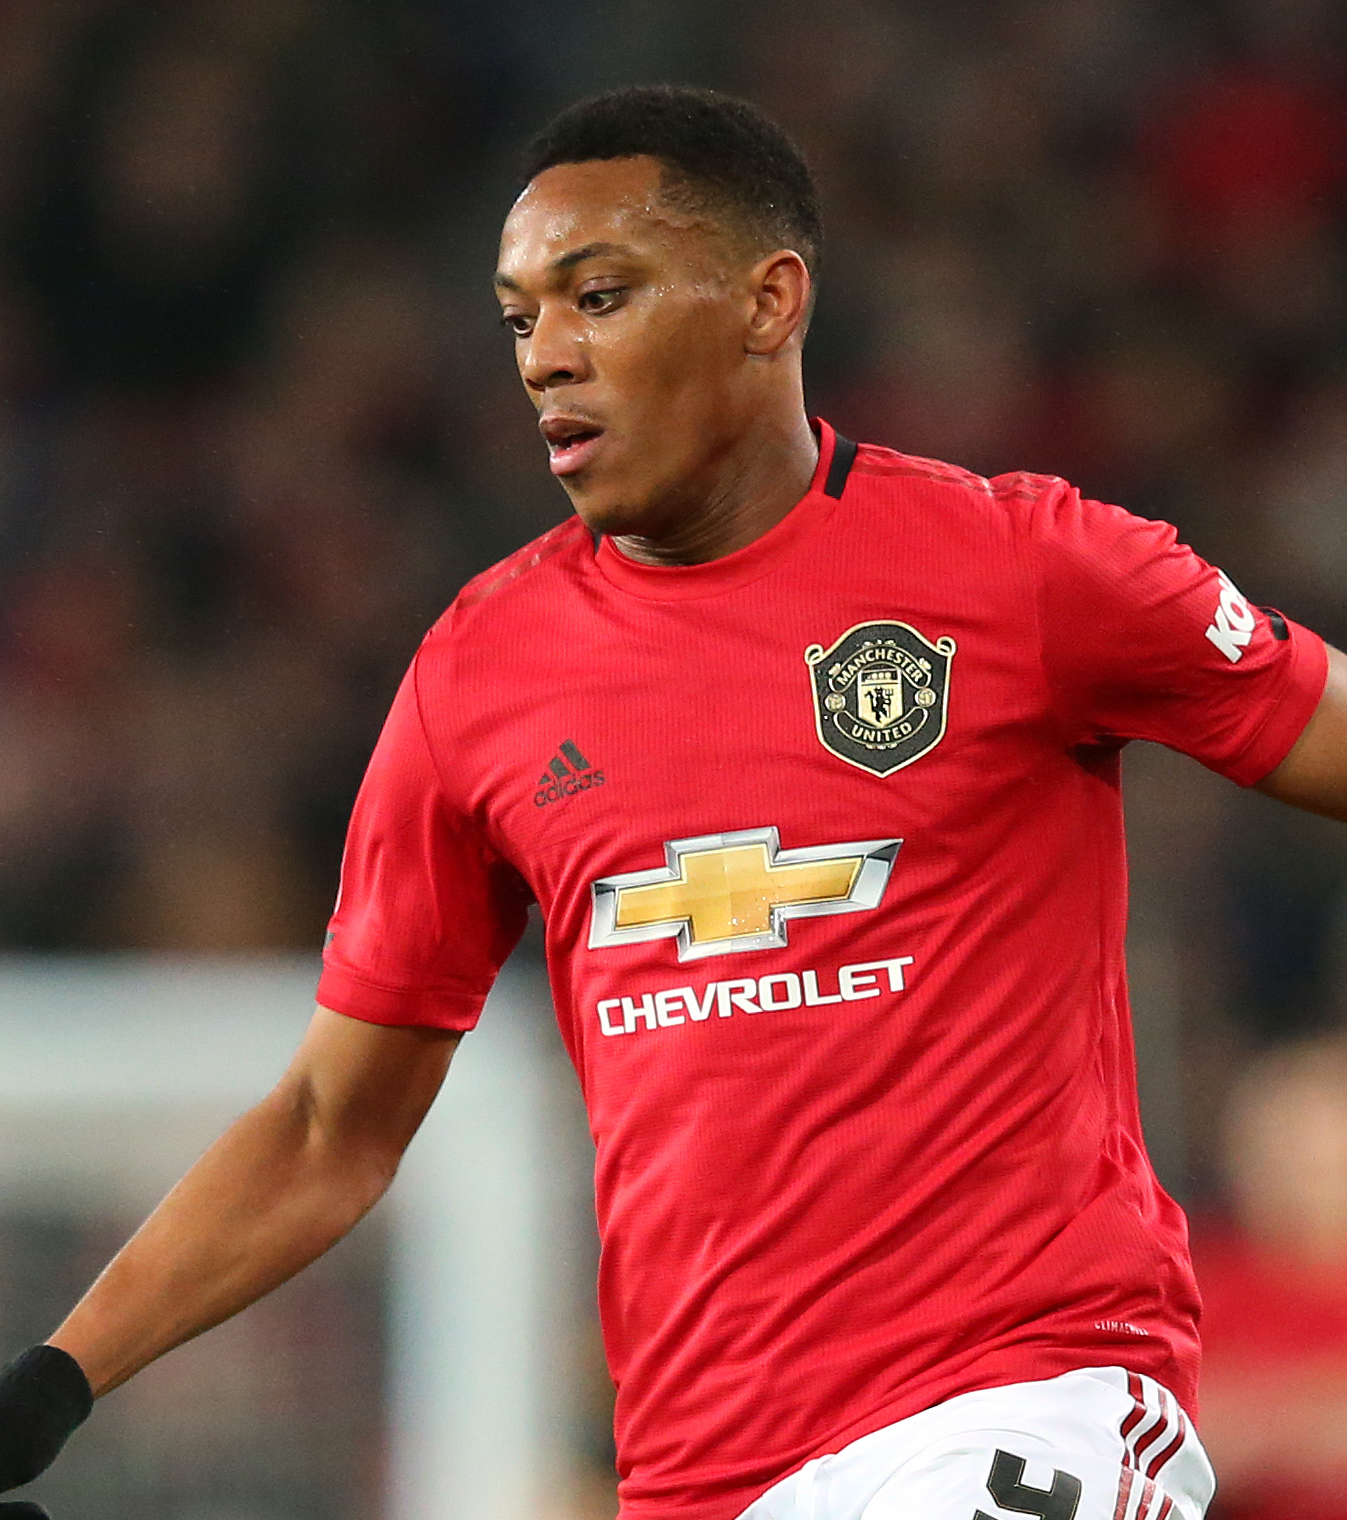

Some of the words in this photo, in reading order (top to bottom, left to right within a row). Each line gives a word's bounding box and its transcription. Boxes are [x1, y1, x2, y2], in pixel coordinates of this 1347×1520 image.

[837, 648, 923, 686] MANCHESTER
[852, 721, 912, 743] UNITED
[534, 770, 606, 807] adidas
[596, 956, 914, 1036] CHEVROLET
